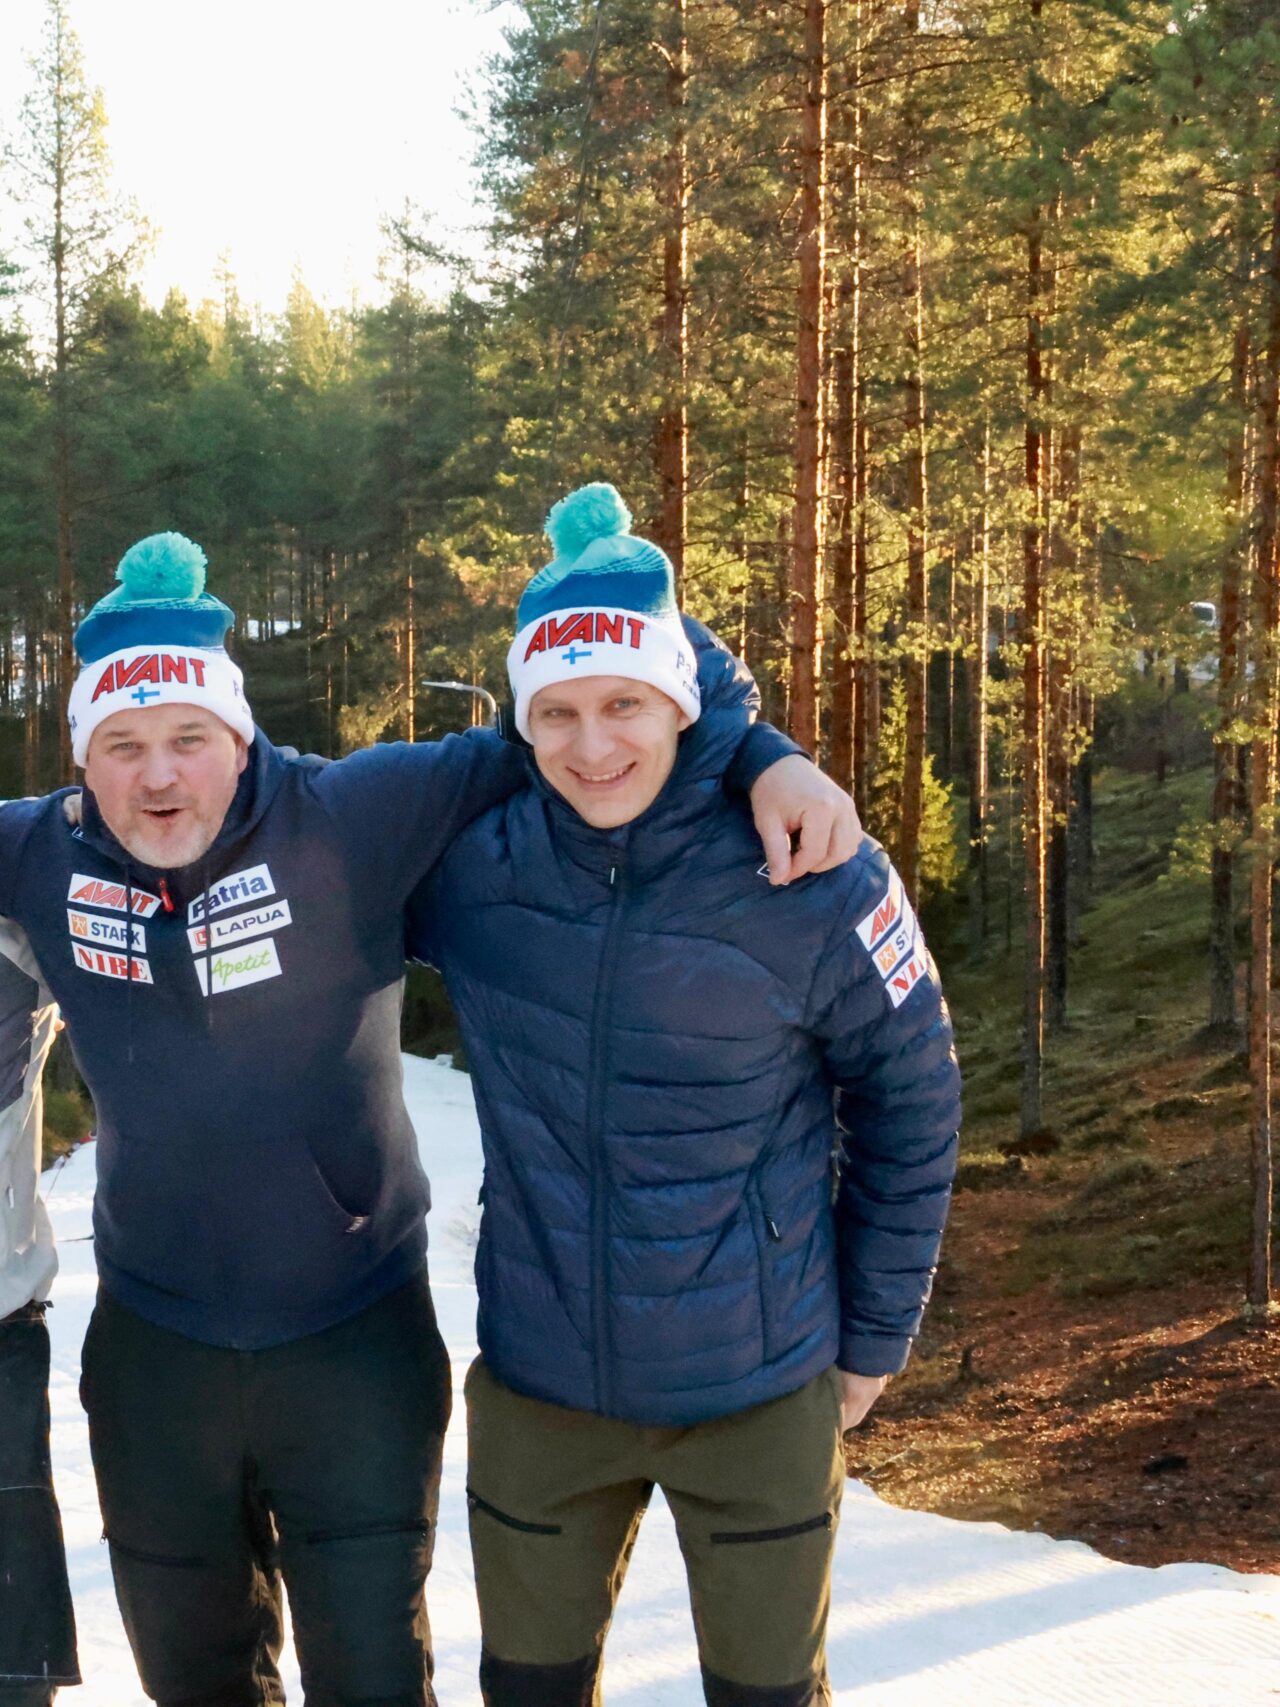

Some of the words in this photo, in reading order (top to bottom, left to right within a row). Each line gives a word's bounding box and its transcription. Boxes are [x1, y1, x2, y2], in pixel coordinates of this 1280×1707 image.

[524, 612, 645, 663] AVANT
[91, 654, 205, 704] AVANT
[71, 881, 154, 914] AVANT
[192, 875, 268, 919] Patria
[91, 922, 141, 945] STARK
[217, 909, 285, 937] LAPUA
[77, 948, 150, 980] NIBE
[212, 950, 271, 985] Apetit
